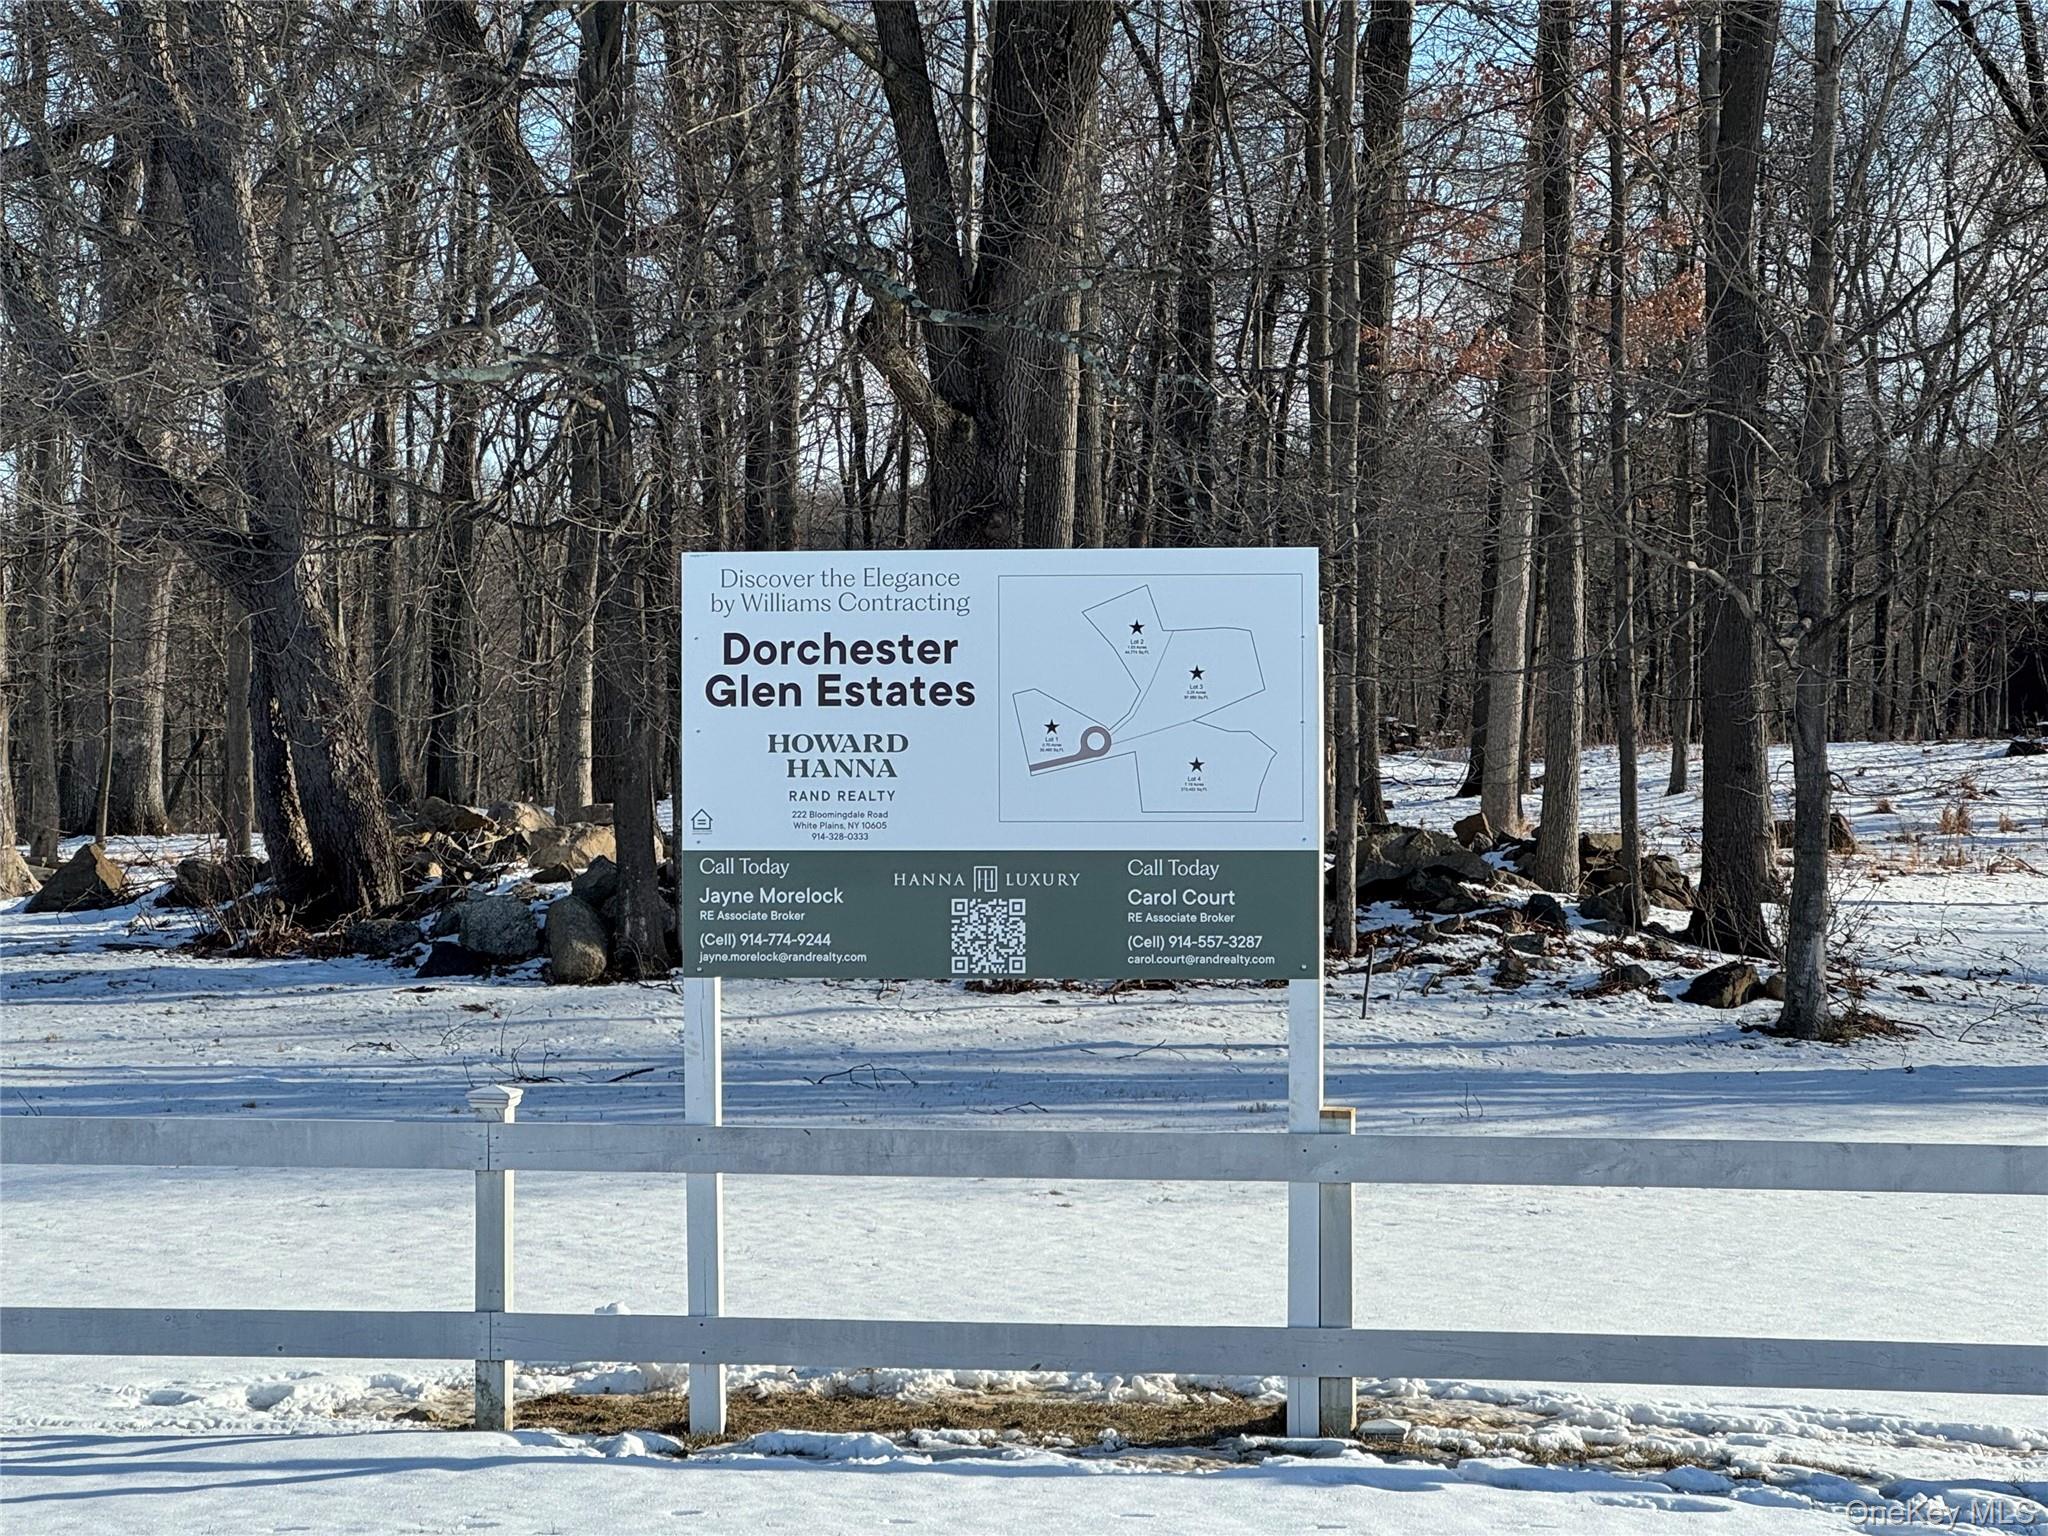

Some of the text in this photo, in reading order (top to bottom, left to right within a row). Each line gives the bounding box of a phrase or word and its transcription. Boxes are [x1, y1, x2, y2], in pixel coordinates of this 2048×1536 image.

[722, 568, 959, 592] Discover the Elegance
[712, 591, 970, 618] by Williams Contracting
[724, 632, 958, 665] Dorchester
[706, 674, 975, 707] Glen Estates
[768, 734, 908, 753] HOWARD
[787, 759, 897, 778] HANNA
[789, 791, 895, 801] RAND REALTY
[809, 811, 865, 820] Bloomingdale
[820, 822, 846, 830] Plains,
[700, 858, 789, 878] Call Today
[1128, 859, 1219, 880] Call Today
[895, 873, 1080, 886] HANNA LUXURY
[699, 888, 843, 907] Jayne Morelock
[1128, 889, 1235, 905] Carol Court
[700, 910, 805, 920] RE Associate Broker
[1128, 912, 1235, 922] RE Associate Broker
[700, 933, 831, 948] (Cell) 914-774-9244
[1128, 935, 1262, 951] (Cell) 914-557-3287
[699, 952, 866, 963] jayne.morelock@randrealty.com
[1128, 954, 1275, 966] carol.court@randrealty.com
